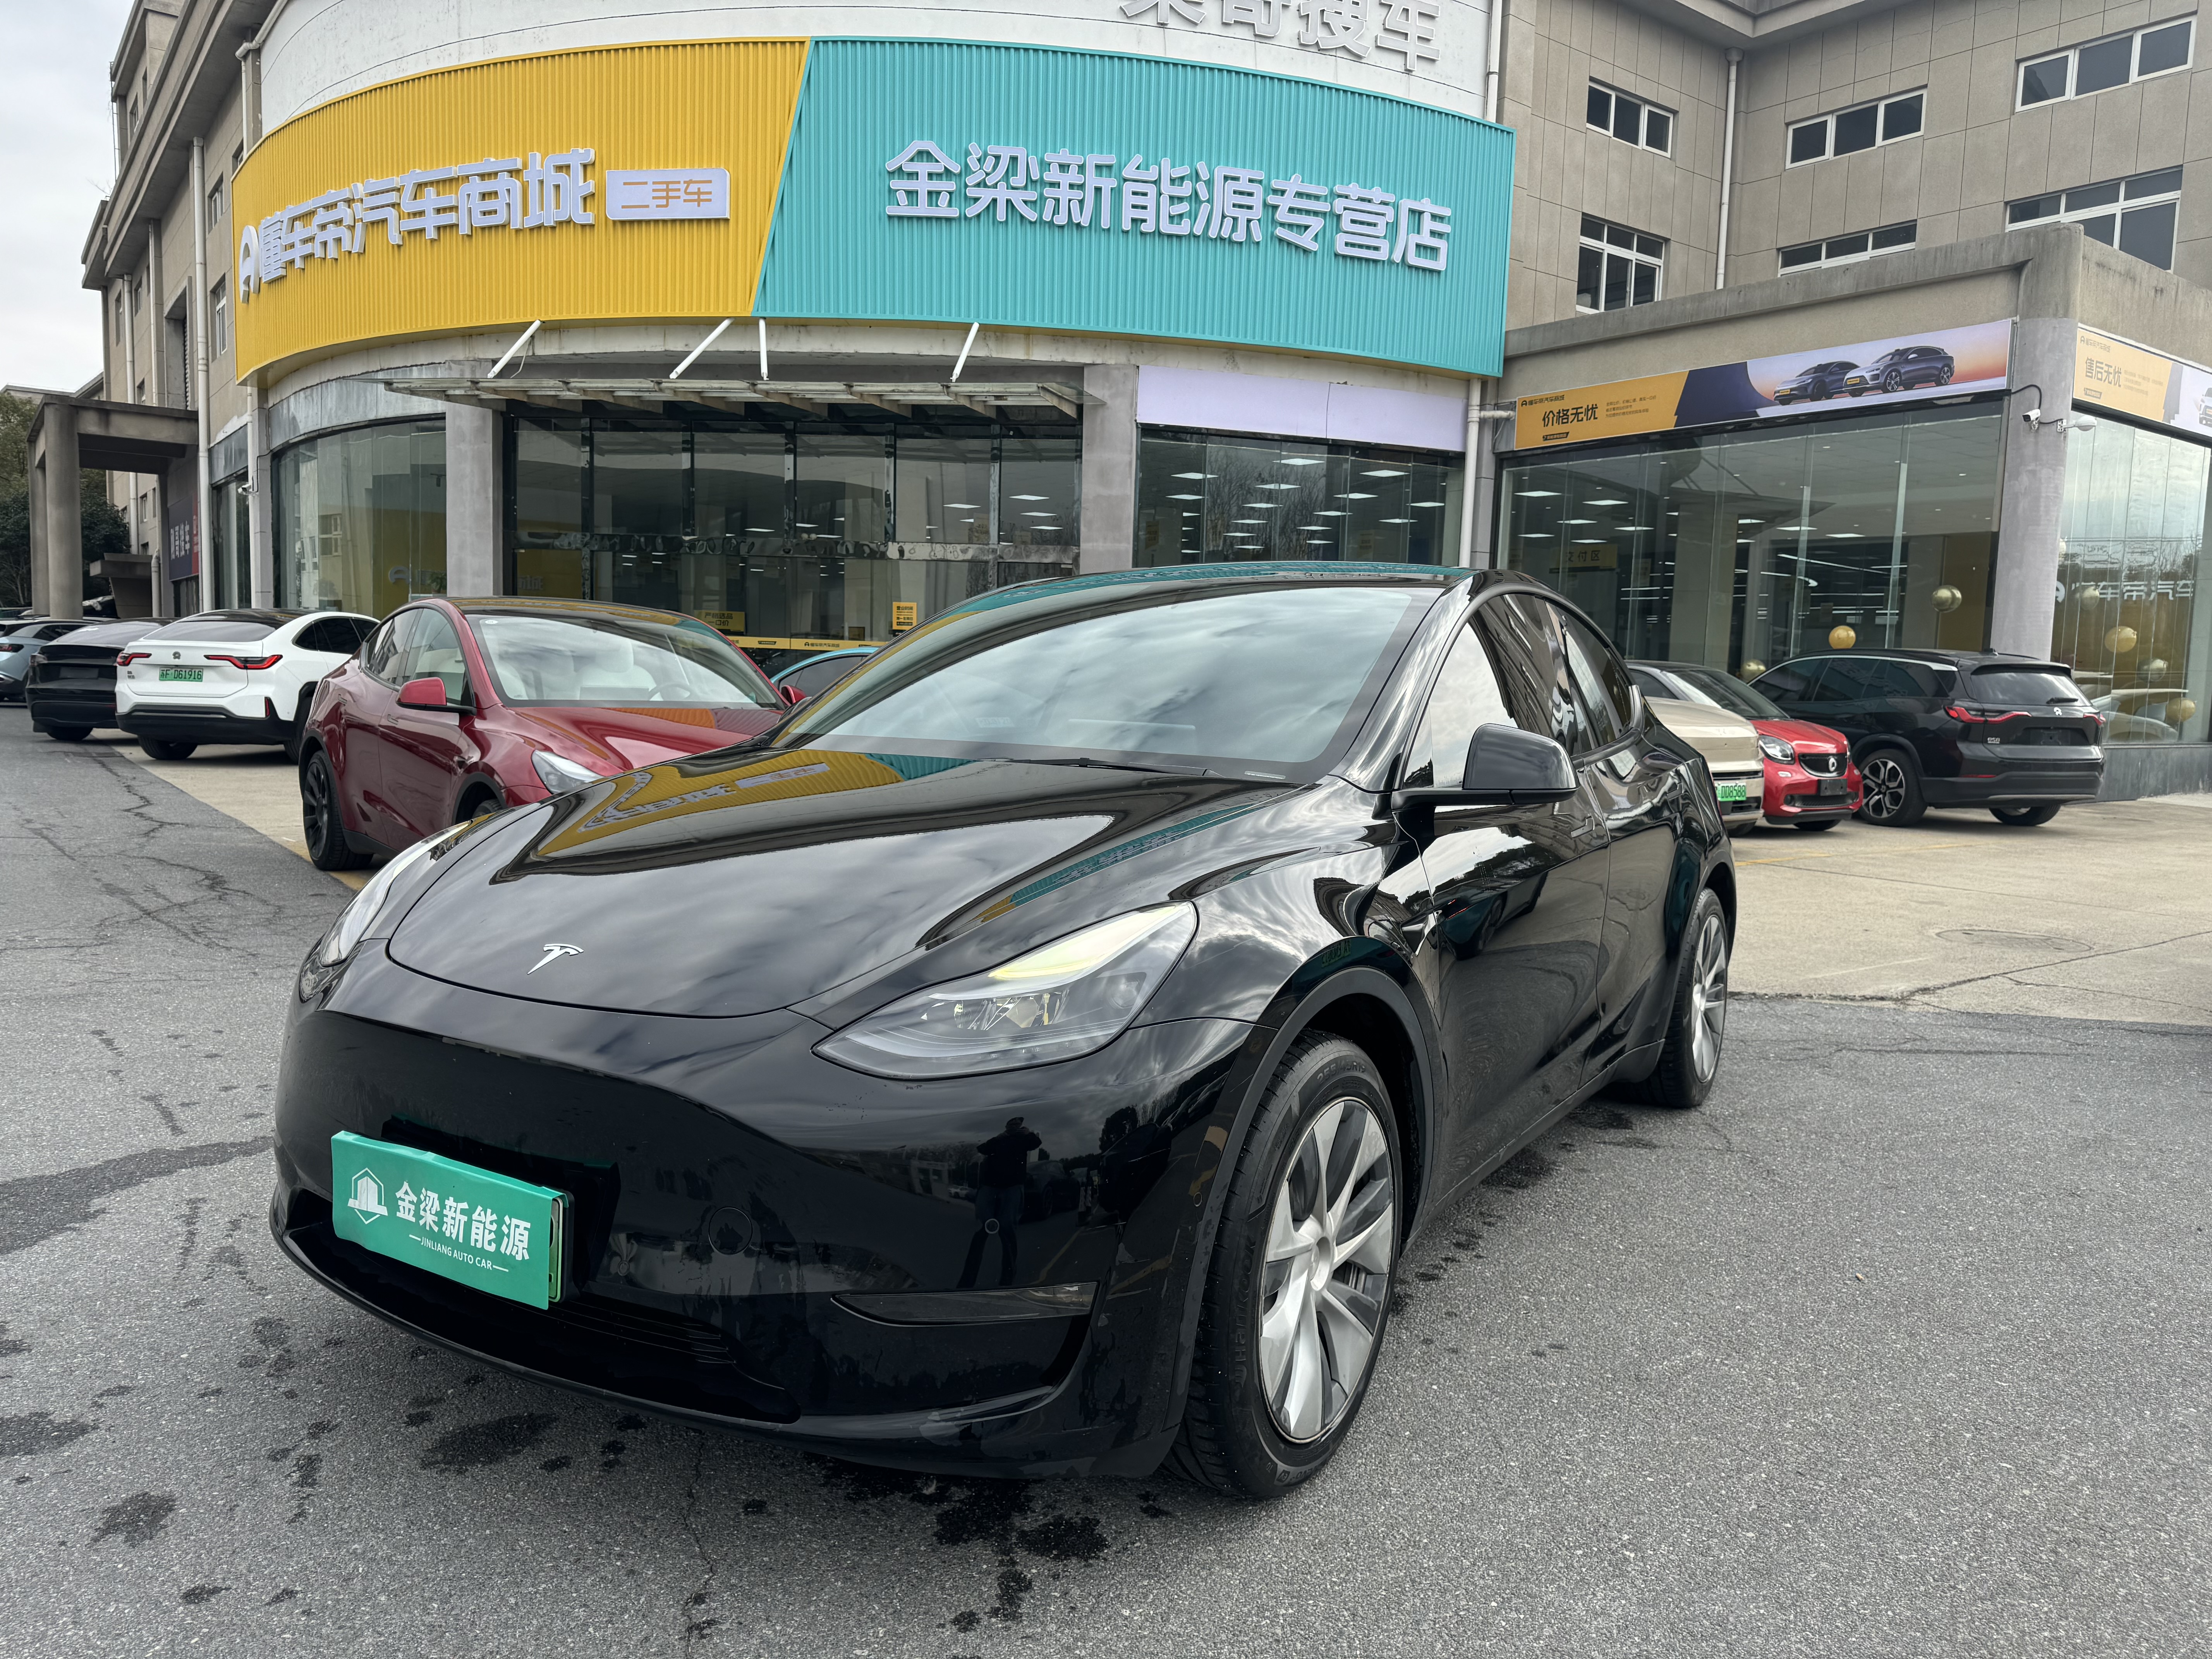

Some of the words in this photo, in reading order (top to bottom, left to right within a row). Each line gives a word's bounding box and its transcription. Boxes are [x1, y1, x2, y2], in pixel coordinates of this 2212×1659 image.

[259, 148, 596, 284] 懂车帝汽车商城
[621, 179, 713, 209] 二手车
[885, 140, 1452, 272] 金梁新能源专营店
[2085, 356, 2122, 388] 售后无忧
[1542, 404, 1598, 428] 价格无忧
[1566, 550, 1601, 562] 交付区
[395, 1181, 531, 1261] 金梁新能源
[421, 1237, 452, 1256] JINLIANG
[453, 1250, 474, 1264] AUTO
[476, 1257, 492, 1270] CAR
